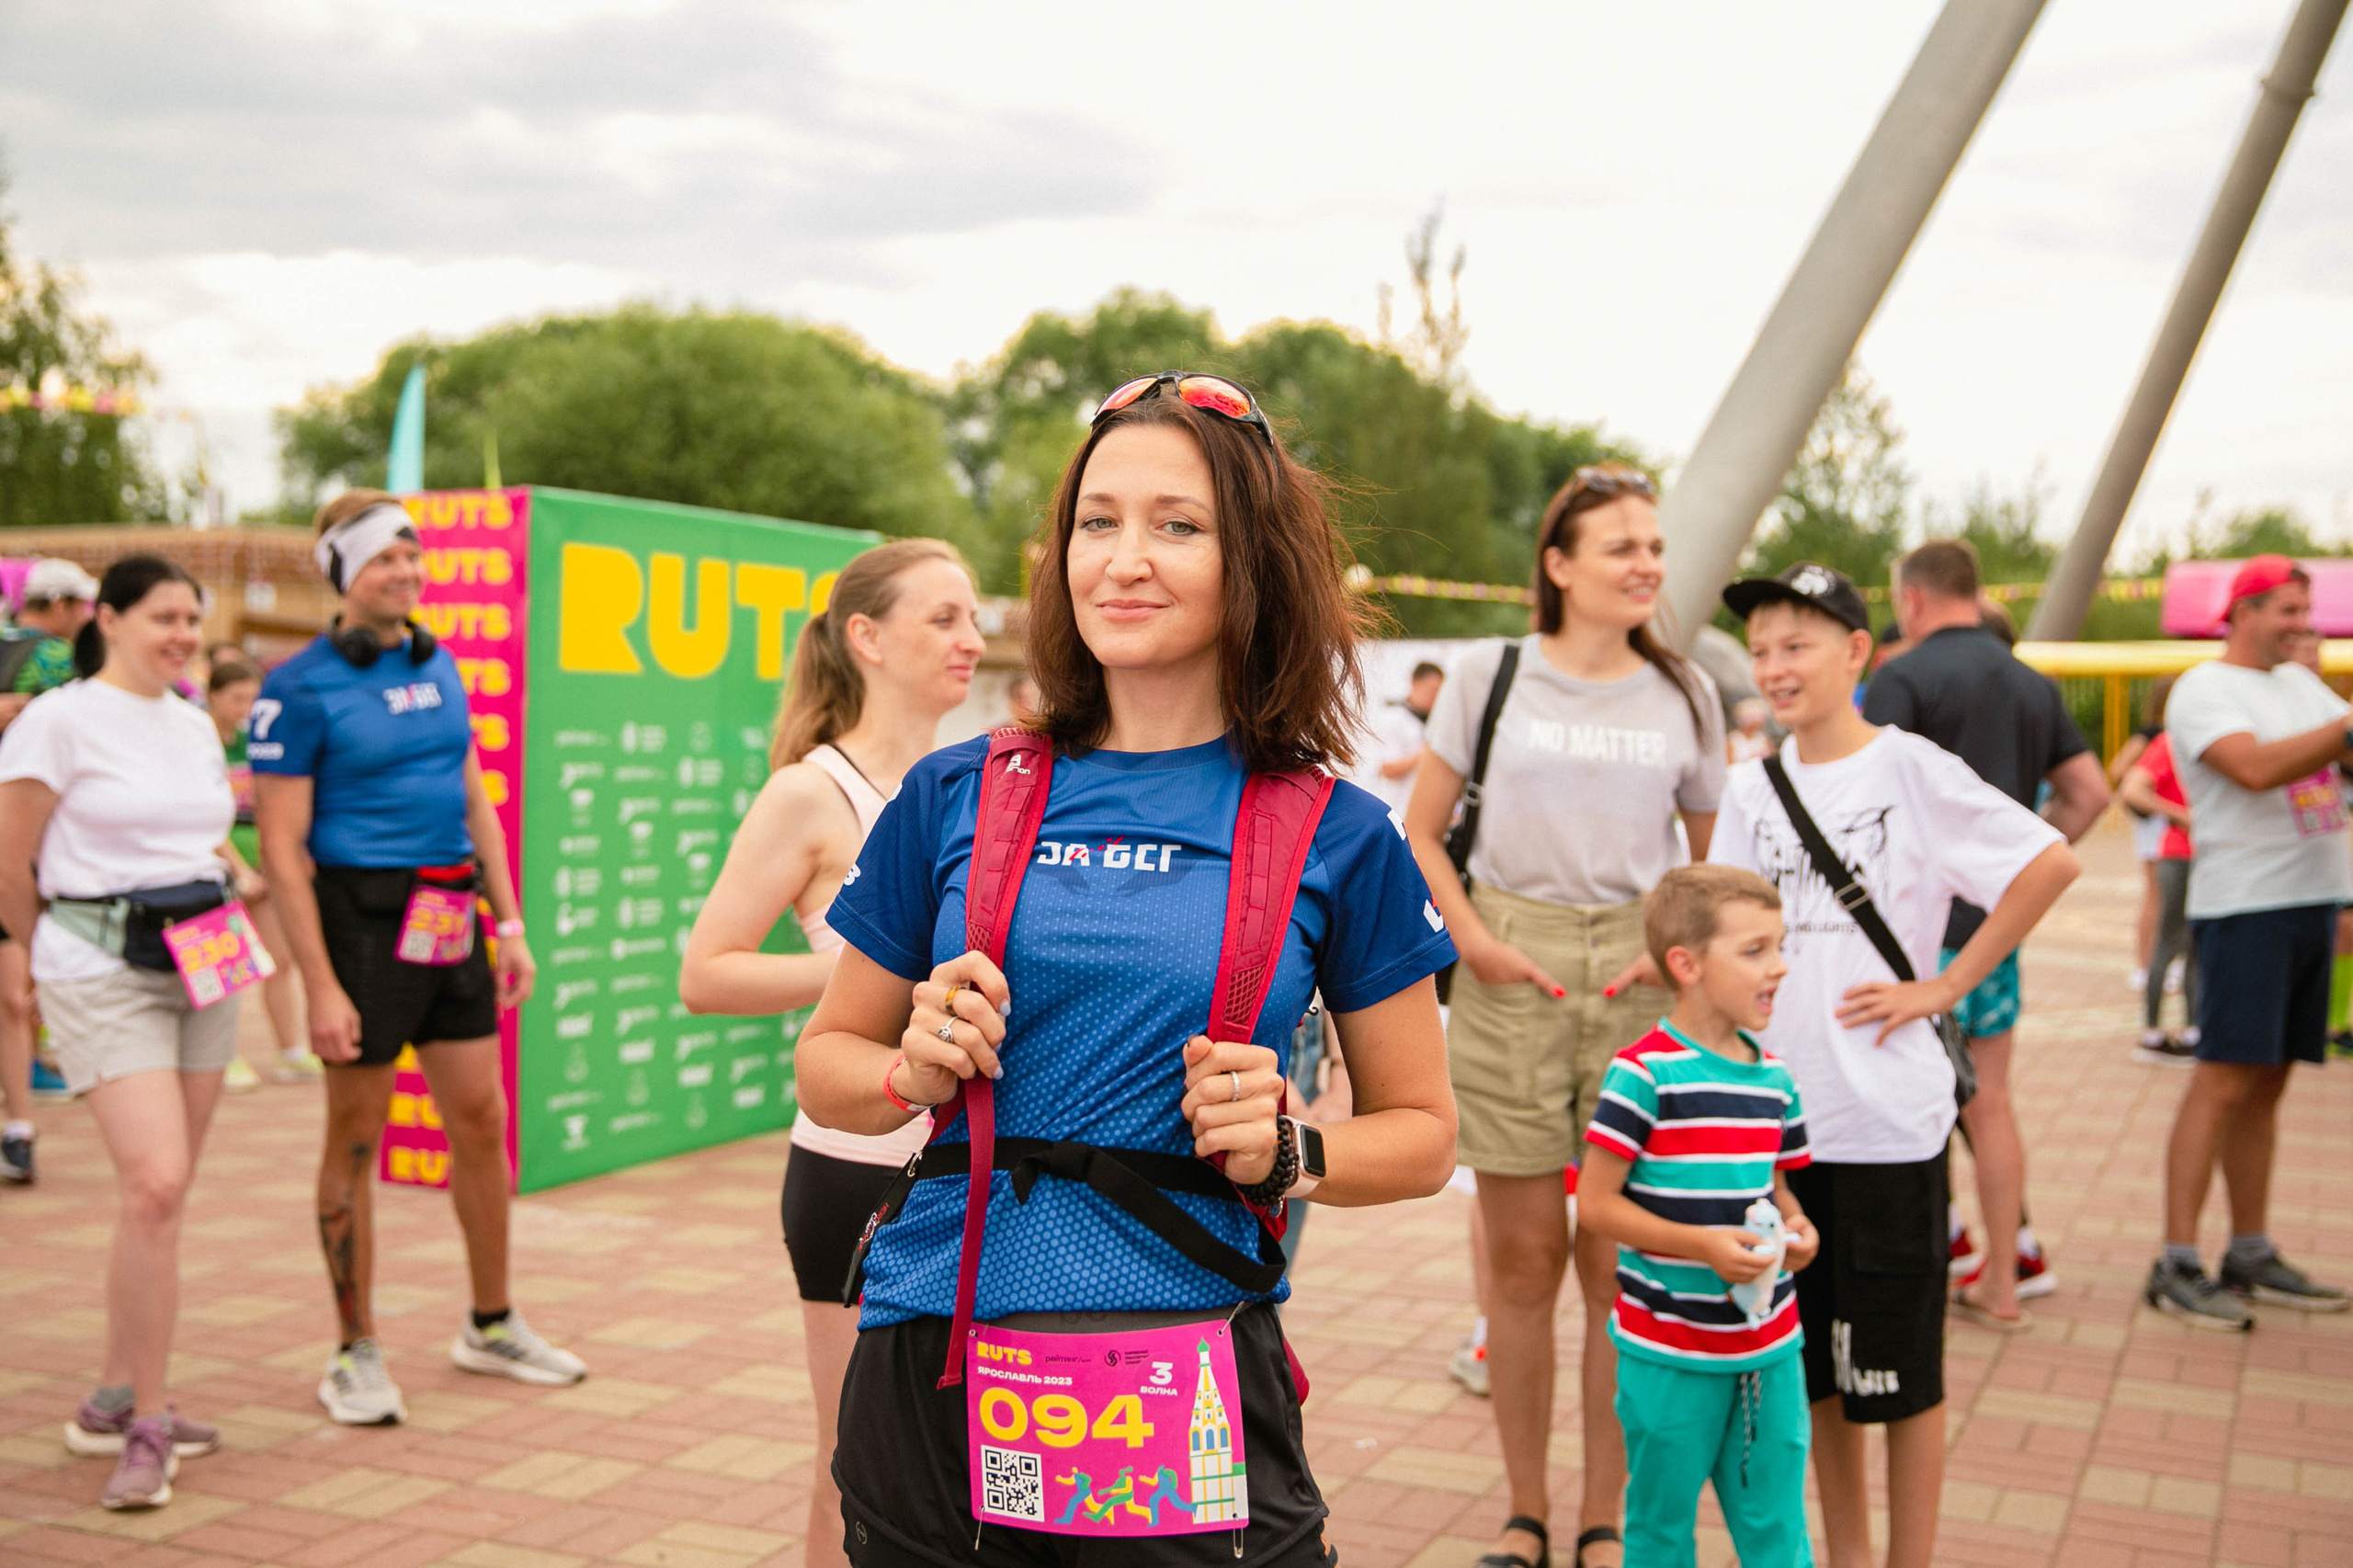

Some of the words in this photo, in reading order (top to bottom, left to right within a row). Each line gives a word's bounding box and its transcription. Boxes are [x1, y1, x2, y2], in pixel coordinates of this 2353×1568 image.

[421, 547, 513, 585] UTS
[457, 657, 512, 697] TS
[251, 699, 283, 740] 7
[1527, 719, 1564, 751] NO
[1568, 723, 1666, 768] MATTER
[178, 930, 241, 974] 230
[389, 1092, 444, 1131] RU
[389, 1145, 450, 1185] RU
[977, 1341, 1033, 1365] RUTS
[977, 1366, 1042, 1384] ЯРОСЛАВЛЬ
[1043, 1375, 1074, 1386] 2023
[1140, 1385, 1178, 1396] ВОЛНА
[1149, 1361, 1174, 1385] 3
[979, 1387, 1154, 1449] 094
